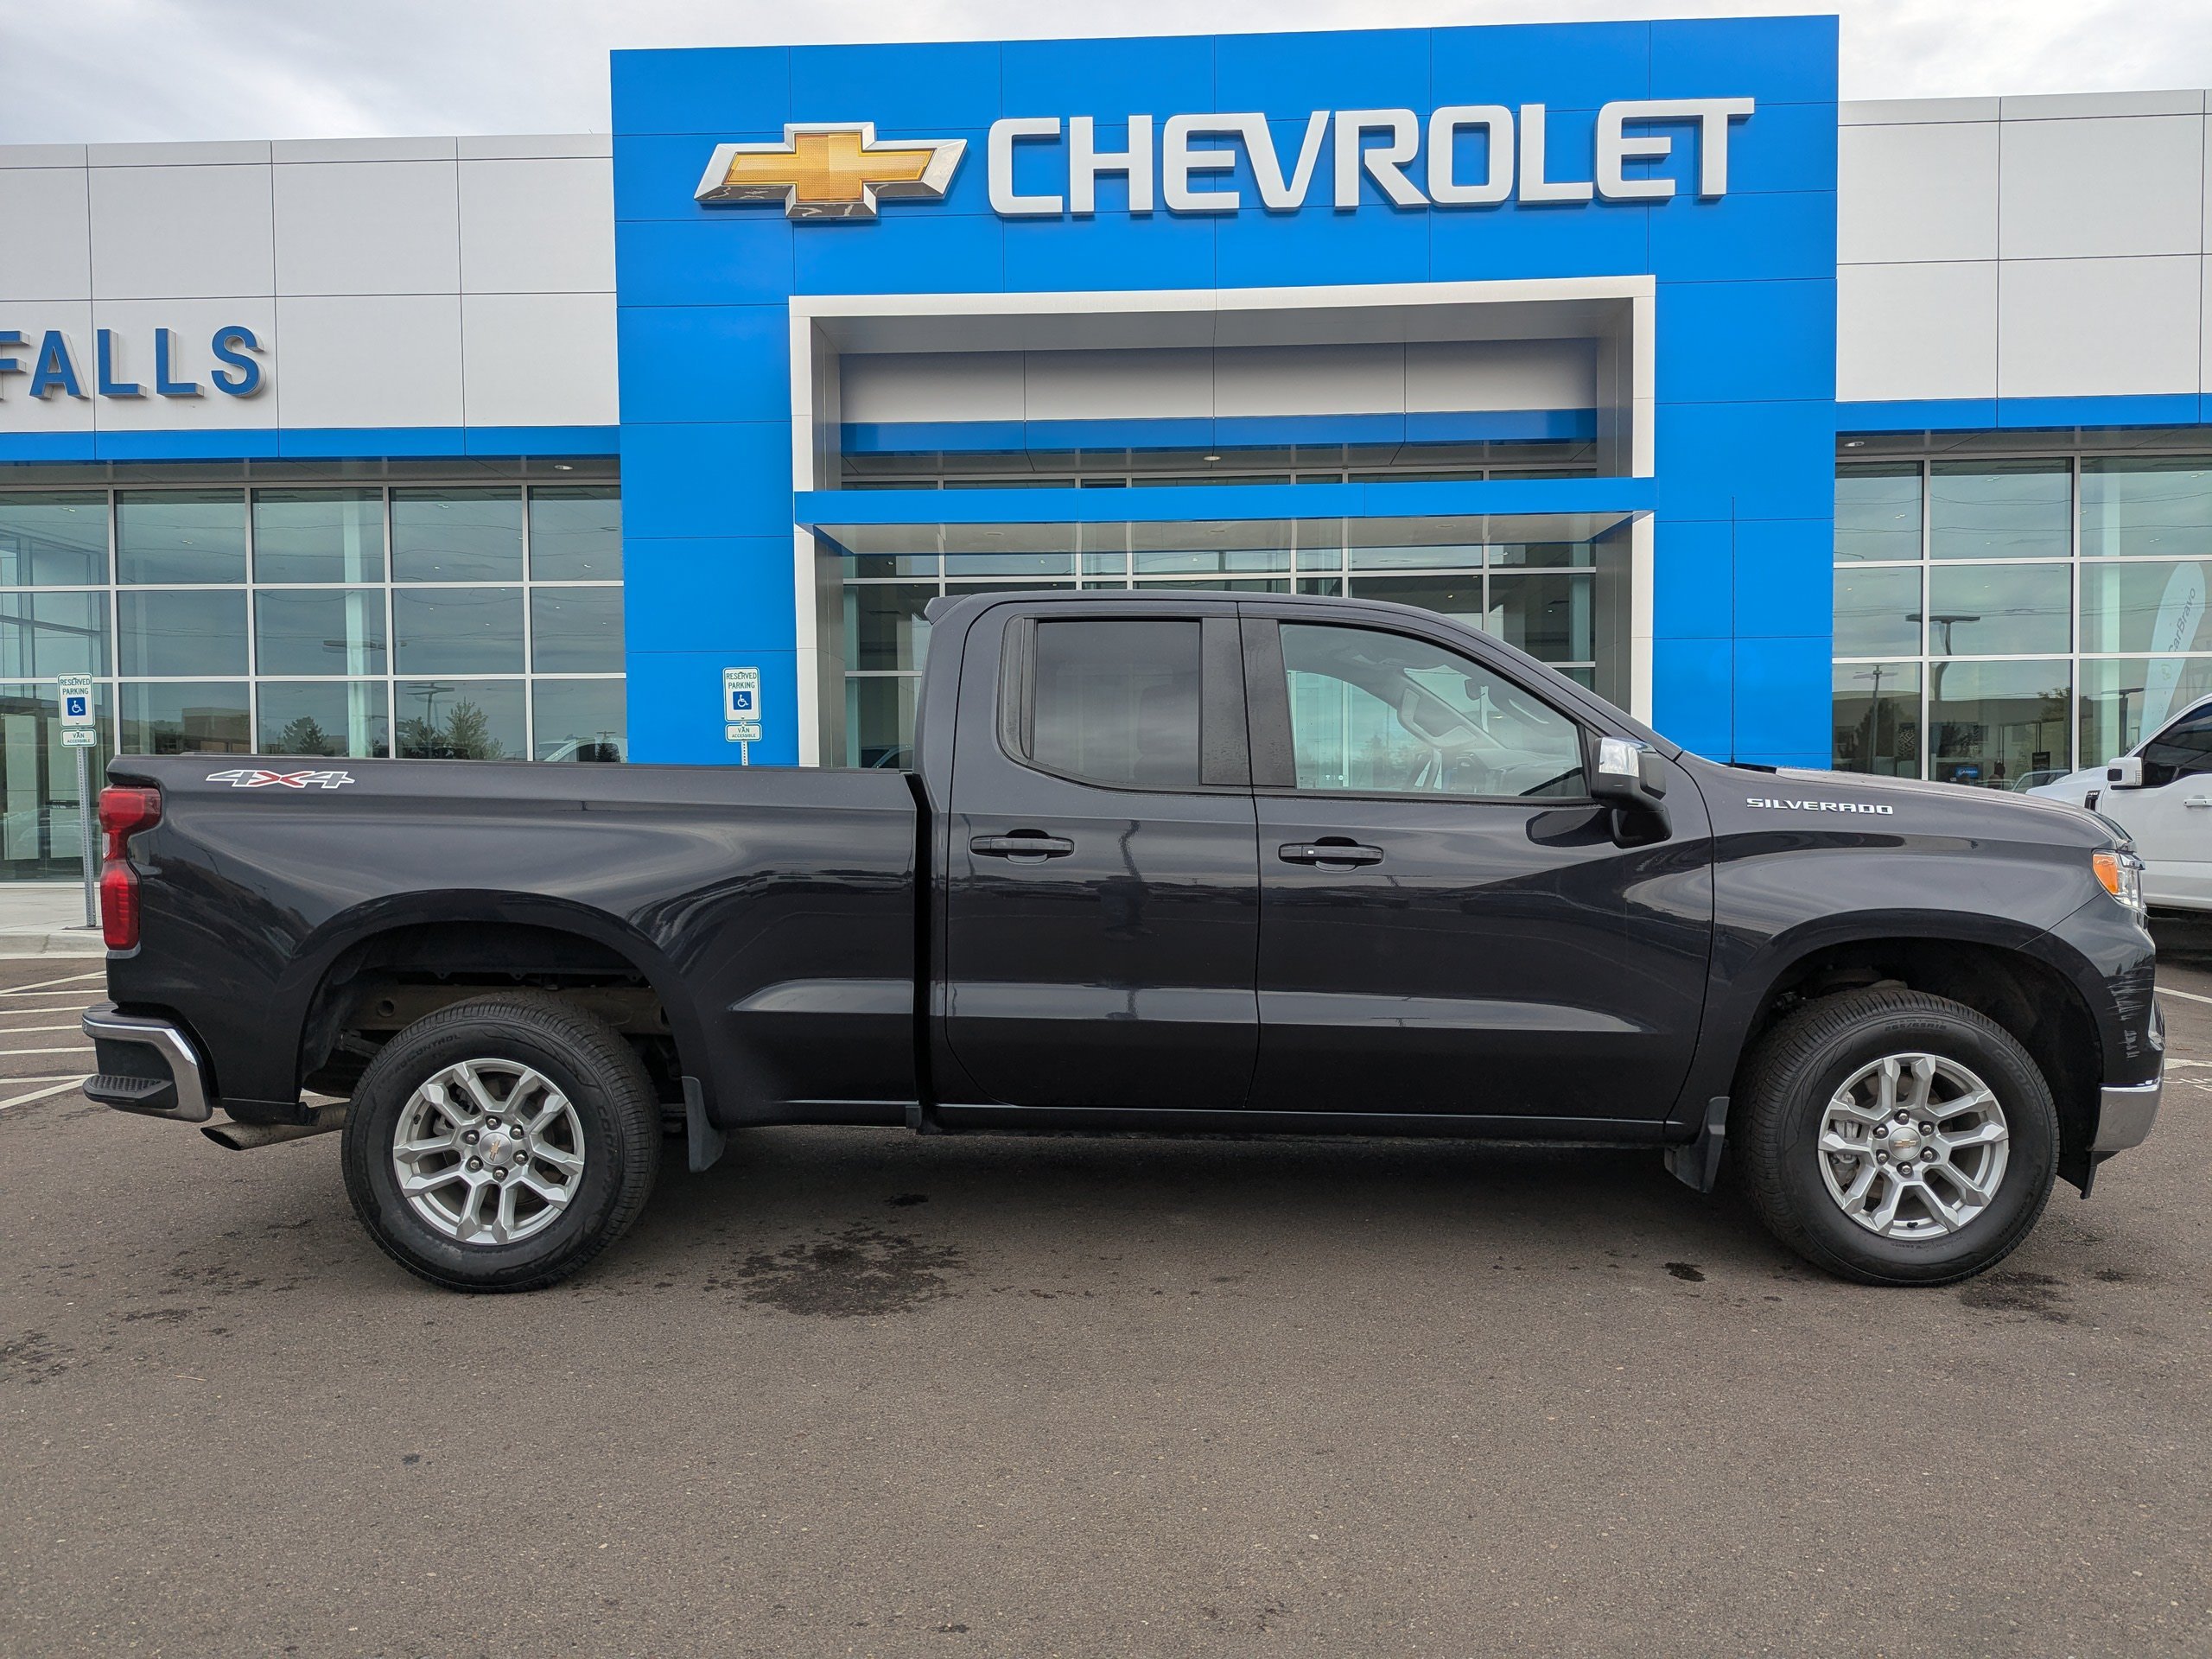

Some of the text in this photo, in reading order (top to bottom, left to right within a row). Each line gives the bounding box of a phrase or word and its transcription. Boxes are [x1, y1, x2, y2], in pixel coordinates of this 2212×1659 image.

[988, 97, 1755, 218] CHEVROLET
[2168, 588, 2196, 652] CarBravo
[1745, 798, 1894, 816] SILVERADO
